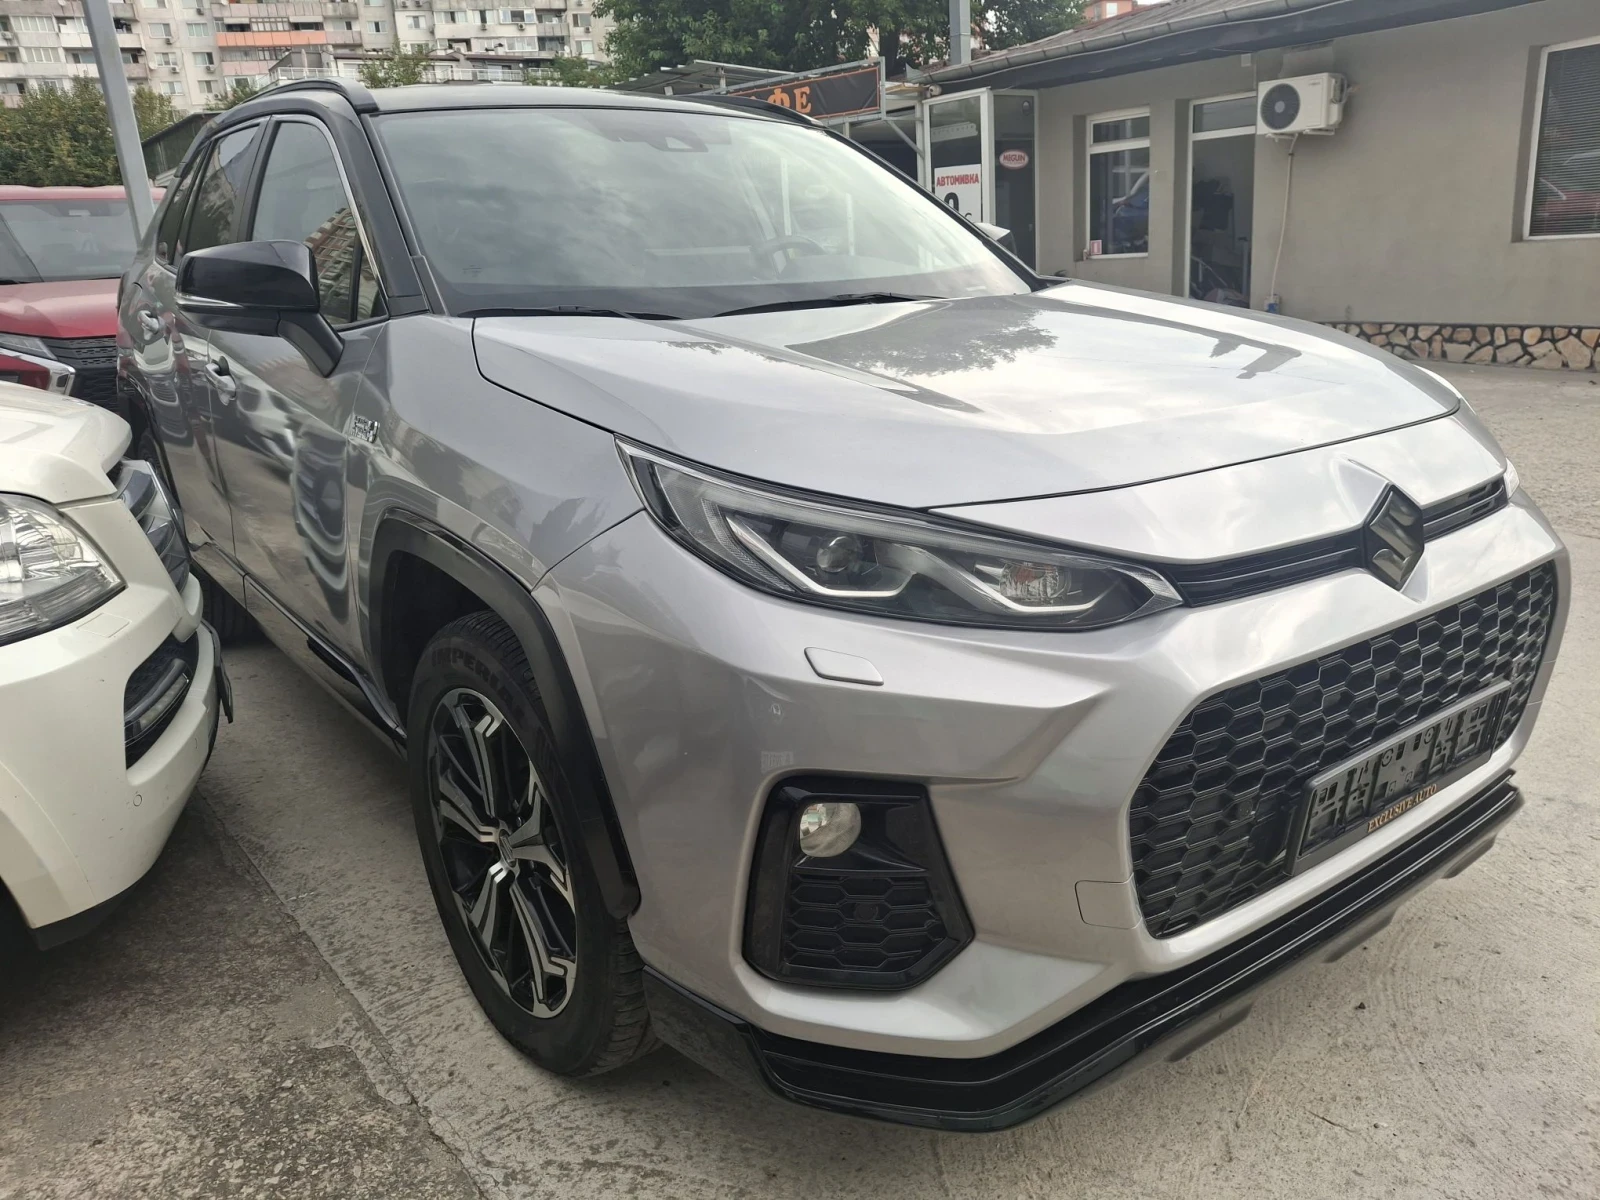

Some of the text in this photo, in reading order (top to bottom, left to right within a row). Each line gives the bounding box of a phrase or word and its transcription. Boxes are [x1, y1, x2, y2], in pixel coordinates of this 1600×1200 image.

[751, 86, 812, 113] ФЕ
[1003, 153, 1026, 162] MEGUIN
[936, 173, 980, 187] АВТОМИВКА
[1368, 783, 1437, 833] EXCLUSIVE AUTO
